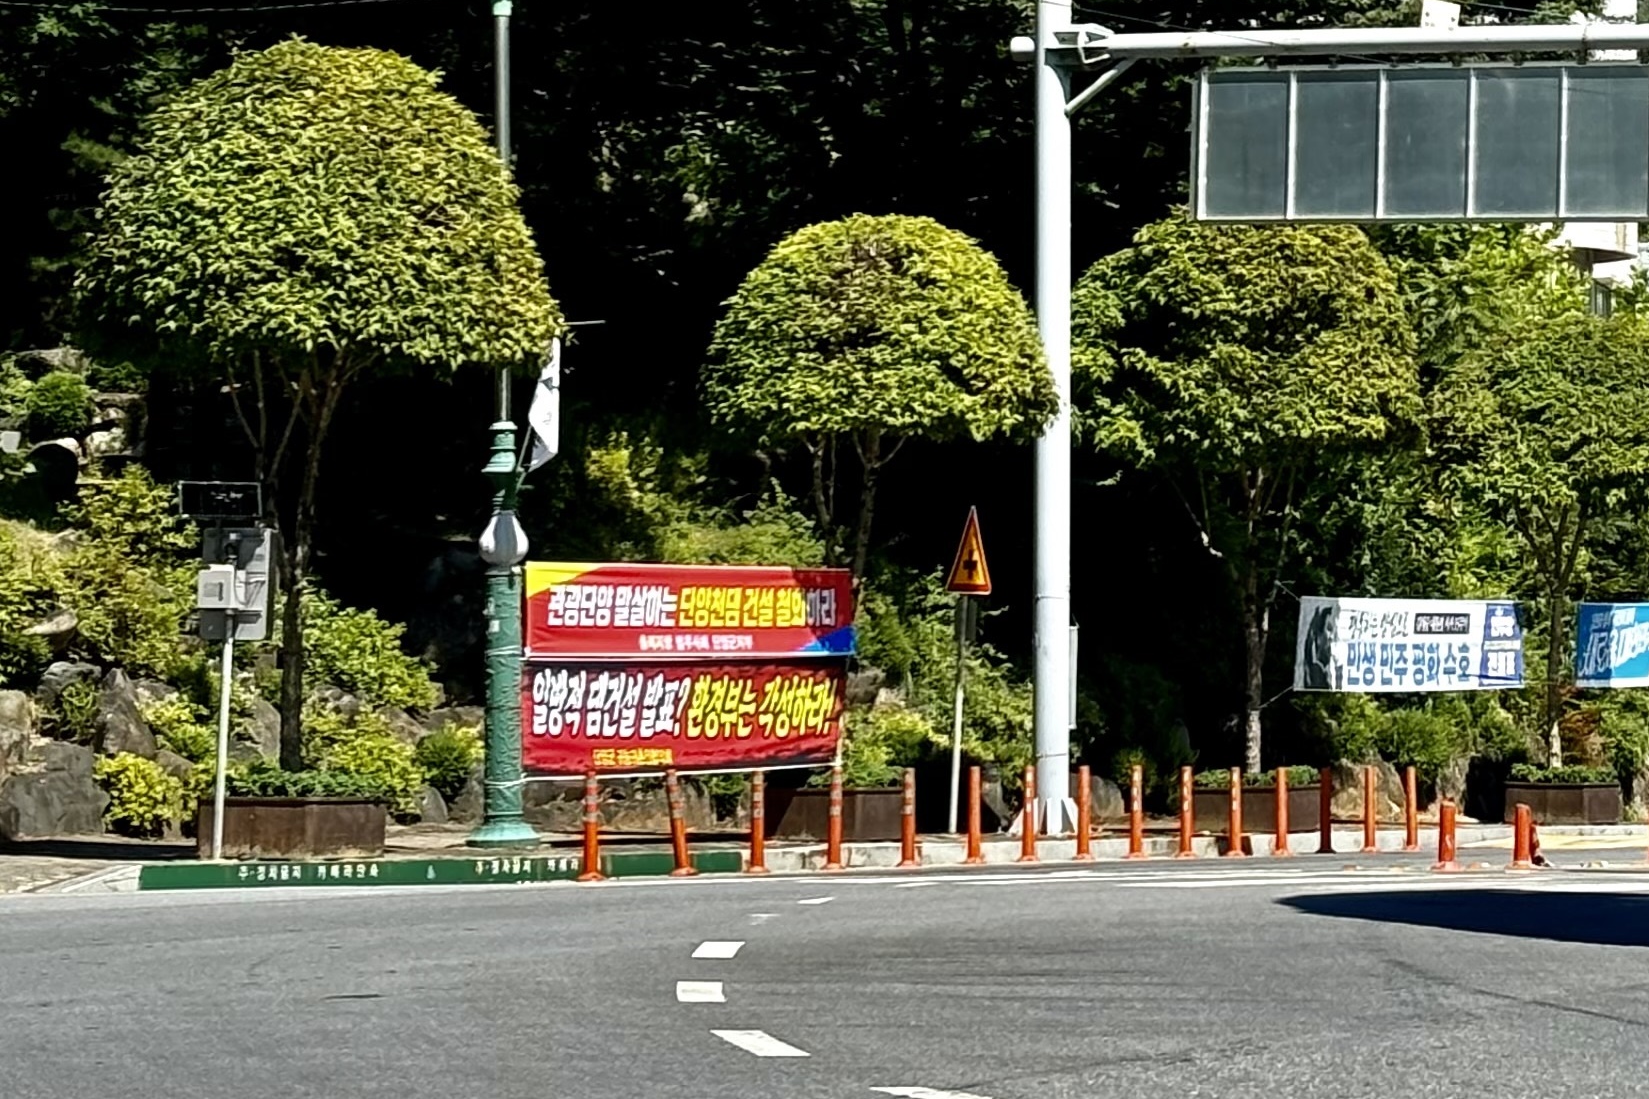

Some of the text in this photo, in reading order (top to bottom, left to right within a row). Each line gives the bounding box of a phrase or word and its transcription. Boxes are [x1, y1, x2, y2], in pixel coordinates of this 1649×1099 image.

[547, 584, 836, 627] 관광단양 말살하는 단양천댐 건설 철회하라
[1347, 642, 1376, 686] 민생
[1380, 642, 1408, 686] 민주
[1412, 642, 1440, 686] 평화
[1443, 642, 1470, 685] 수호
[532, 669, 837, 738] 일방적 댐건설 발표? 환경부는 각성하라!
